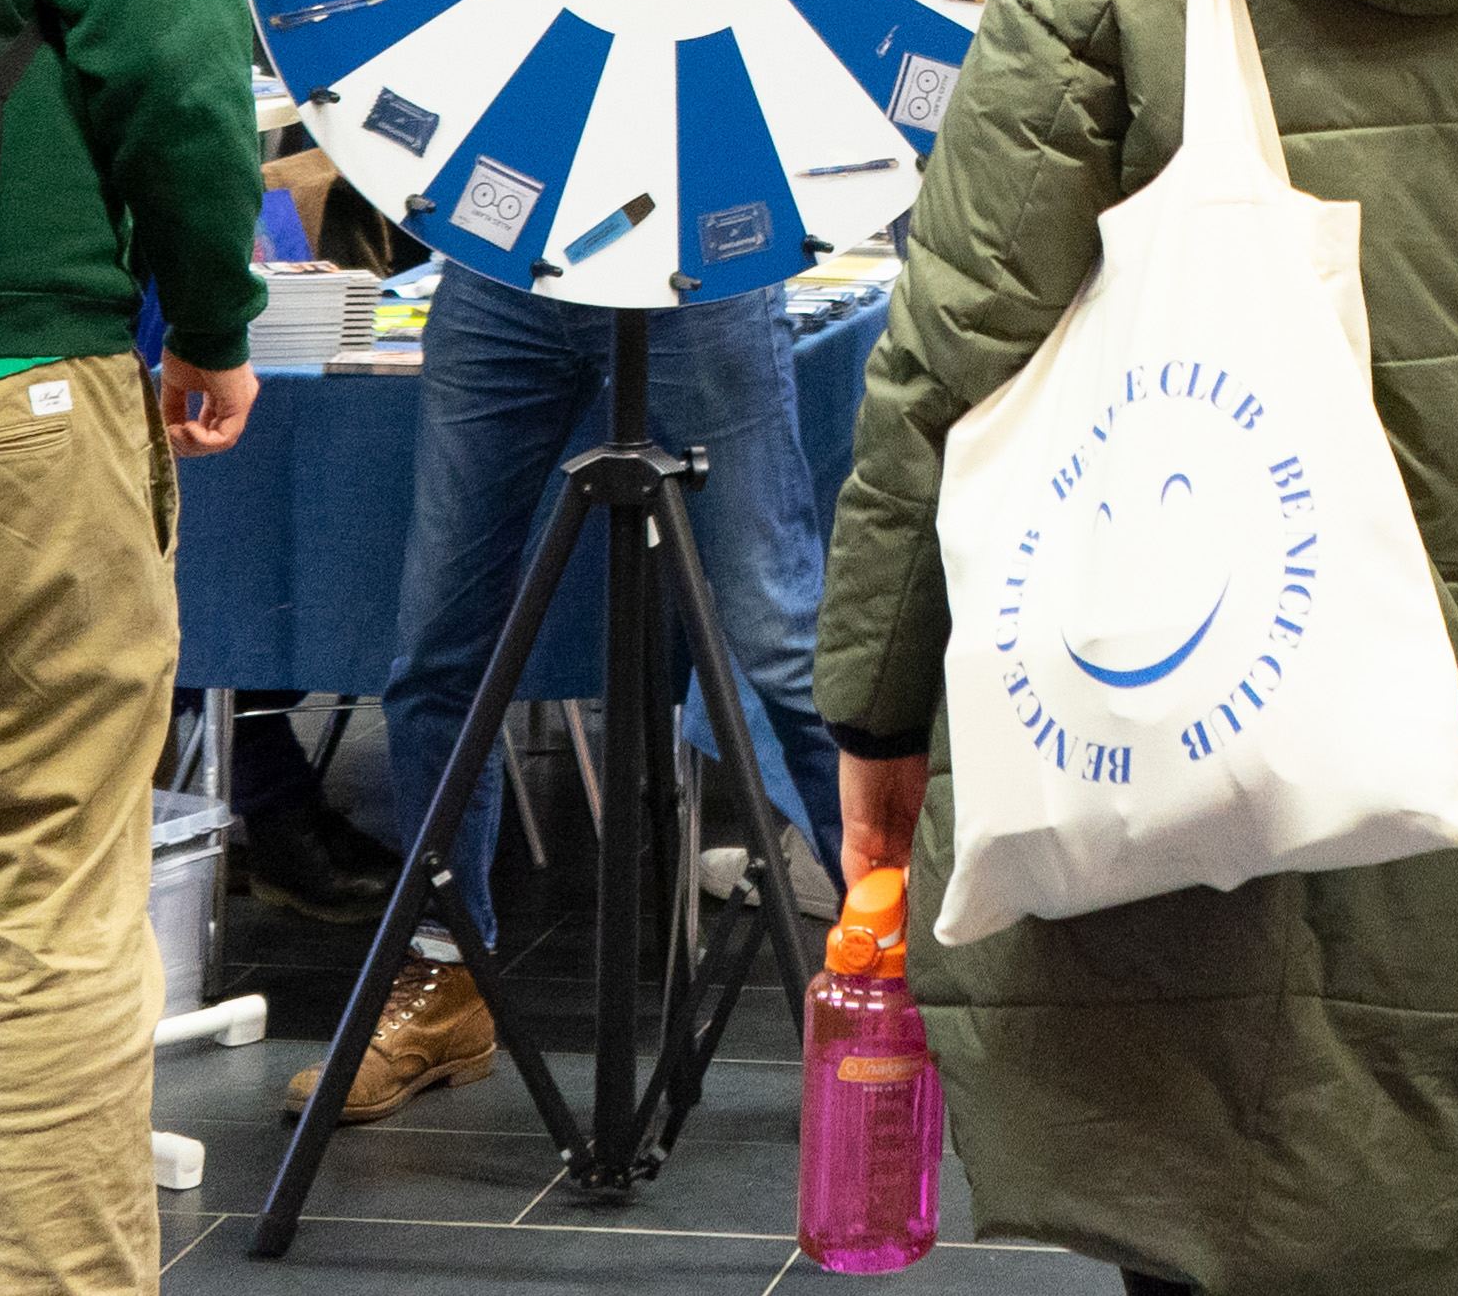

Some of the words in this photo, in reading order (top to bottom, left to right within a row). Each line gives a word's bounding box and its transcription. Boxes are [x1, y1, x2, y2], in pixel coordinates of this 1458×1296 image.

[1159, 360, 1265, 430] CLUB
[1268, 452, 1315, 519] BE
[1269, 530, 1319, 649] NICE
[1002, 660, 1079, 772] NICE
[1181, 654, 1282, 761] CLUB
[1081, 741, 1134, 785] BE
